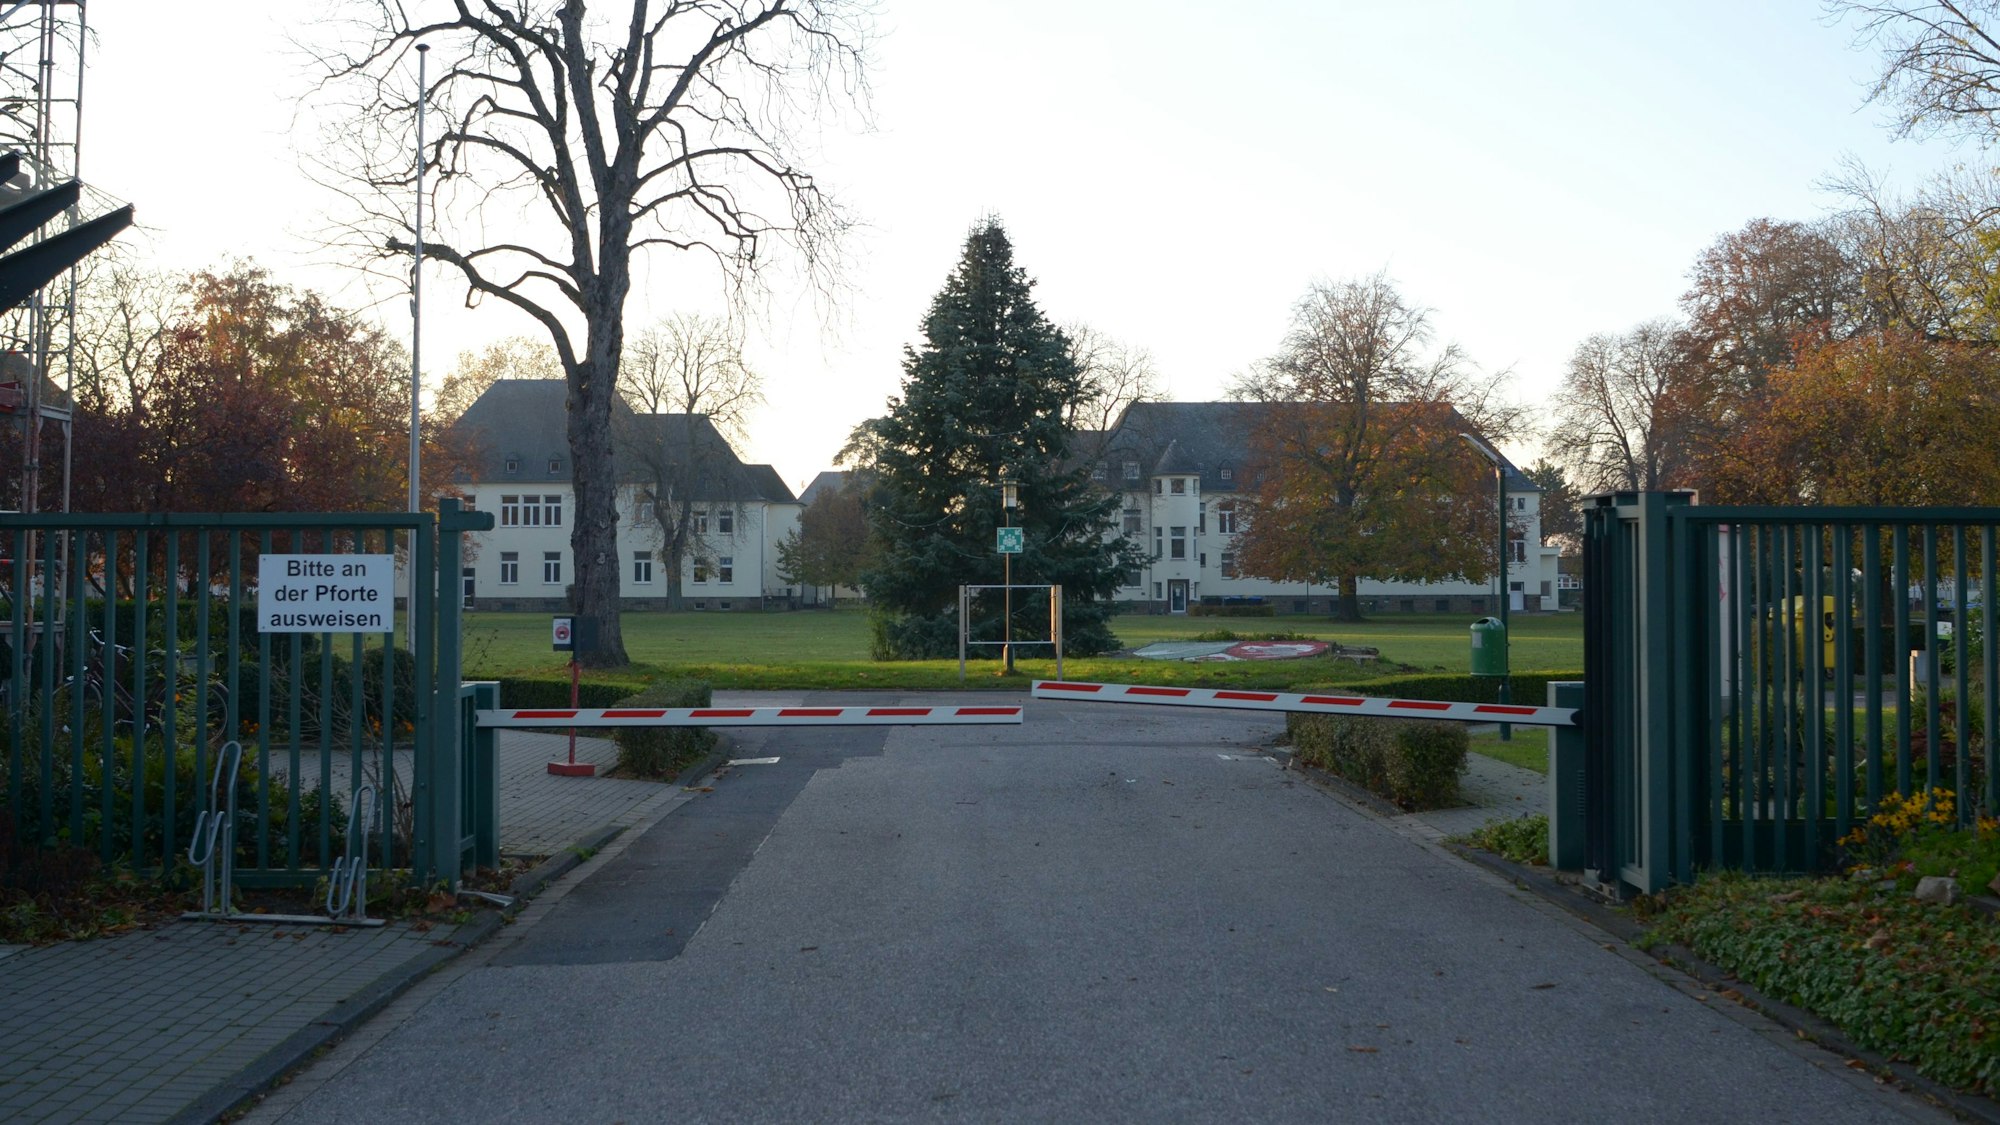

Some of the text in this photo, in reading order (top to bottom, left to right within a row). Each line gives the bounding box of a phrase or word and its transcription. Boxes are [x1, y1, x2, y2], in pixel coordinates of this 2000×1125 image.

[287, 560, 366, 577] Bitte an
[275, 585, 378, 601] der Pforte
[270, 610, 381, 626] ausweisen
